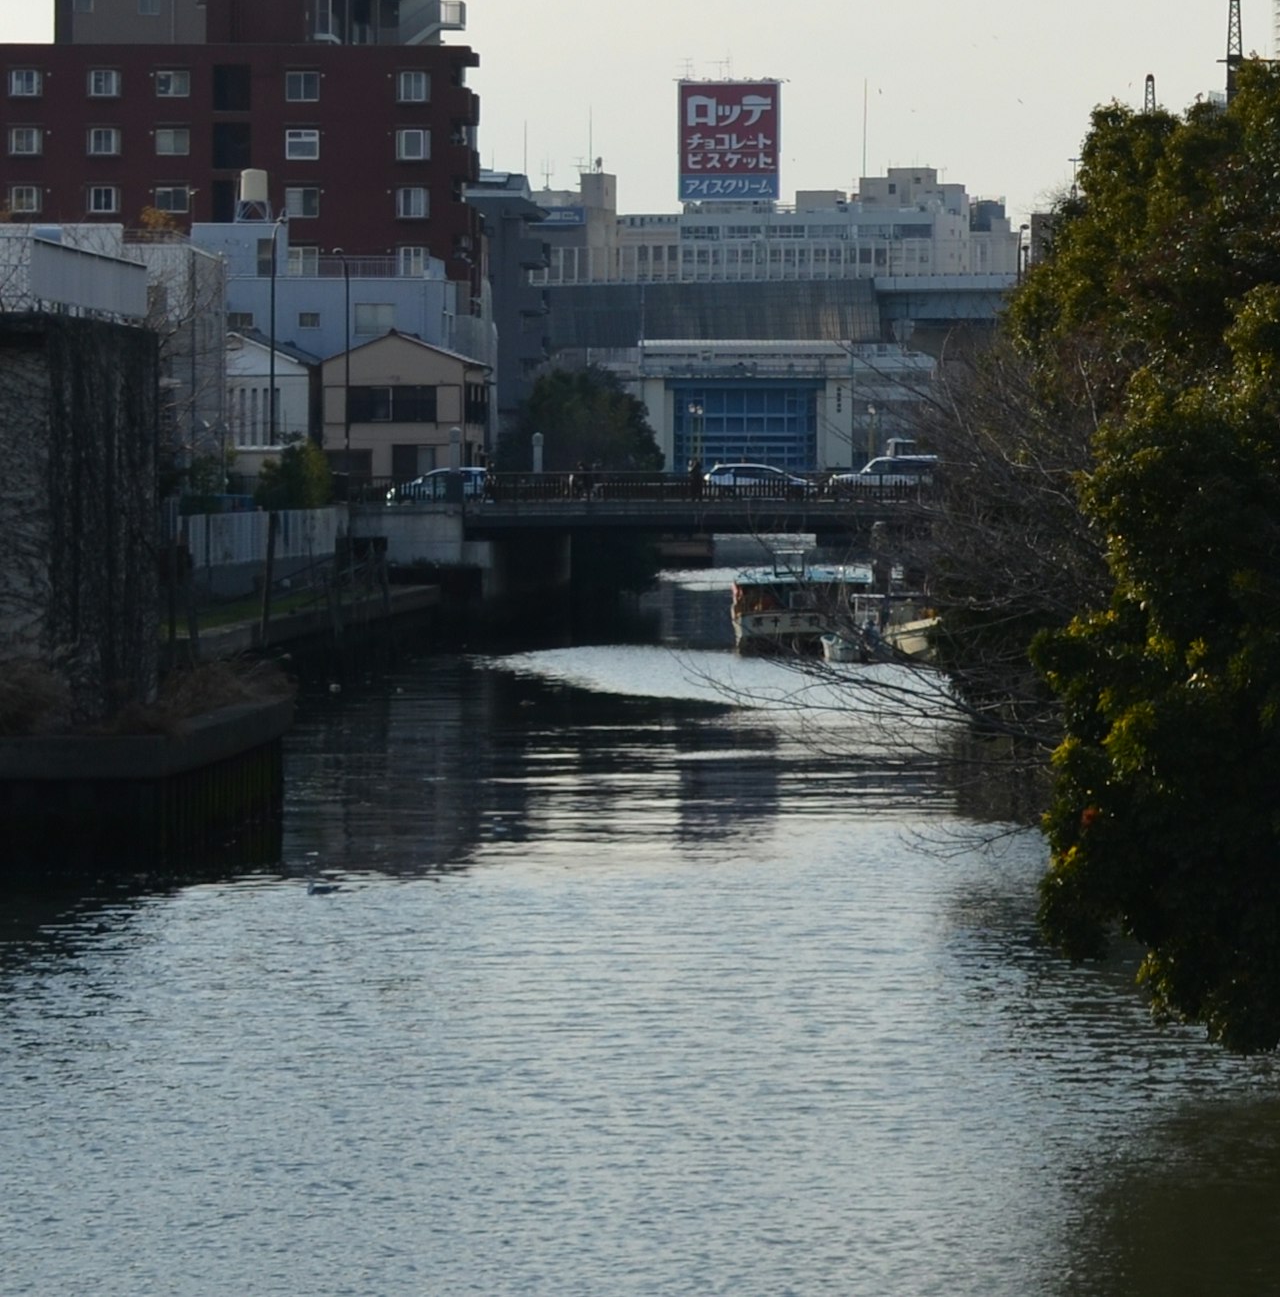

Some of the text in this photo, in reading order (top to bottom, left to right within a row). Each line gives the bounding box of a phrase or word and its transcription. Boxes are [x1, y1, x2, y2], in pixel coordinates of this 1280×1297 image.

[687, 95, 772, 126] ロッテ
[687, 133, 772, 150] チョコレート
[687, 153, 773, 169] ビスケット
[685, 179, 773, 194] アイスクリーム
